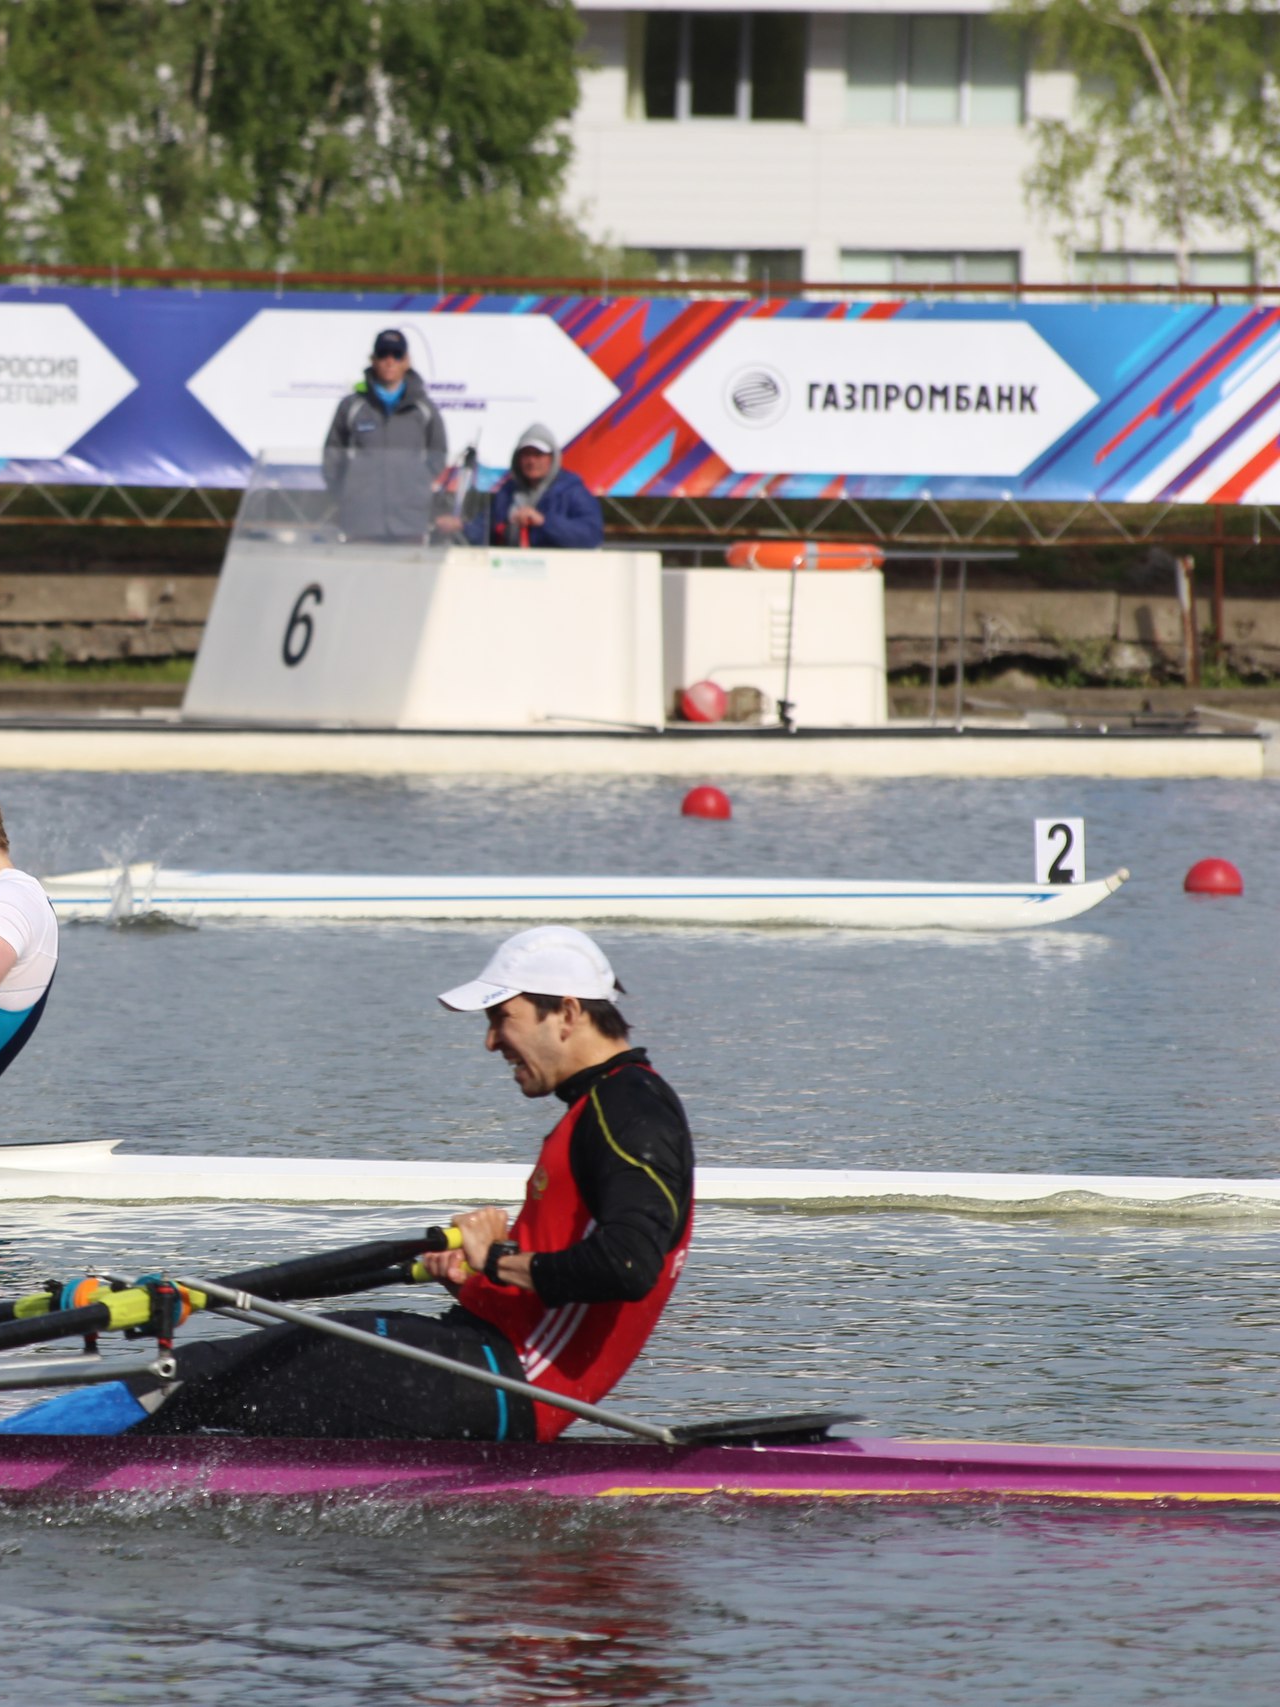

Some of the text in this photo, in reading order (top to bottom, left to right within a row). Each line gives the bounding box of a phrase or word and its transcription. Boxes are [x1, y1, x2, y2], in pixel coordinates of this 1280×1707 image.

[807, 383, 1039, 413] ГАЗПРОМБАНК
[282, 582, 324, 669] 6
[1047, 823, 1074, 884] 2
